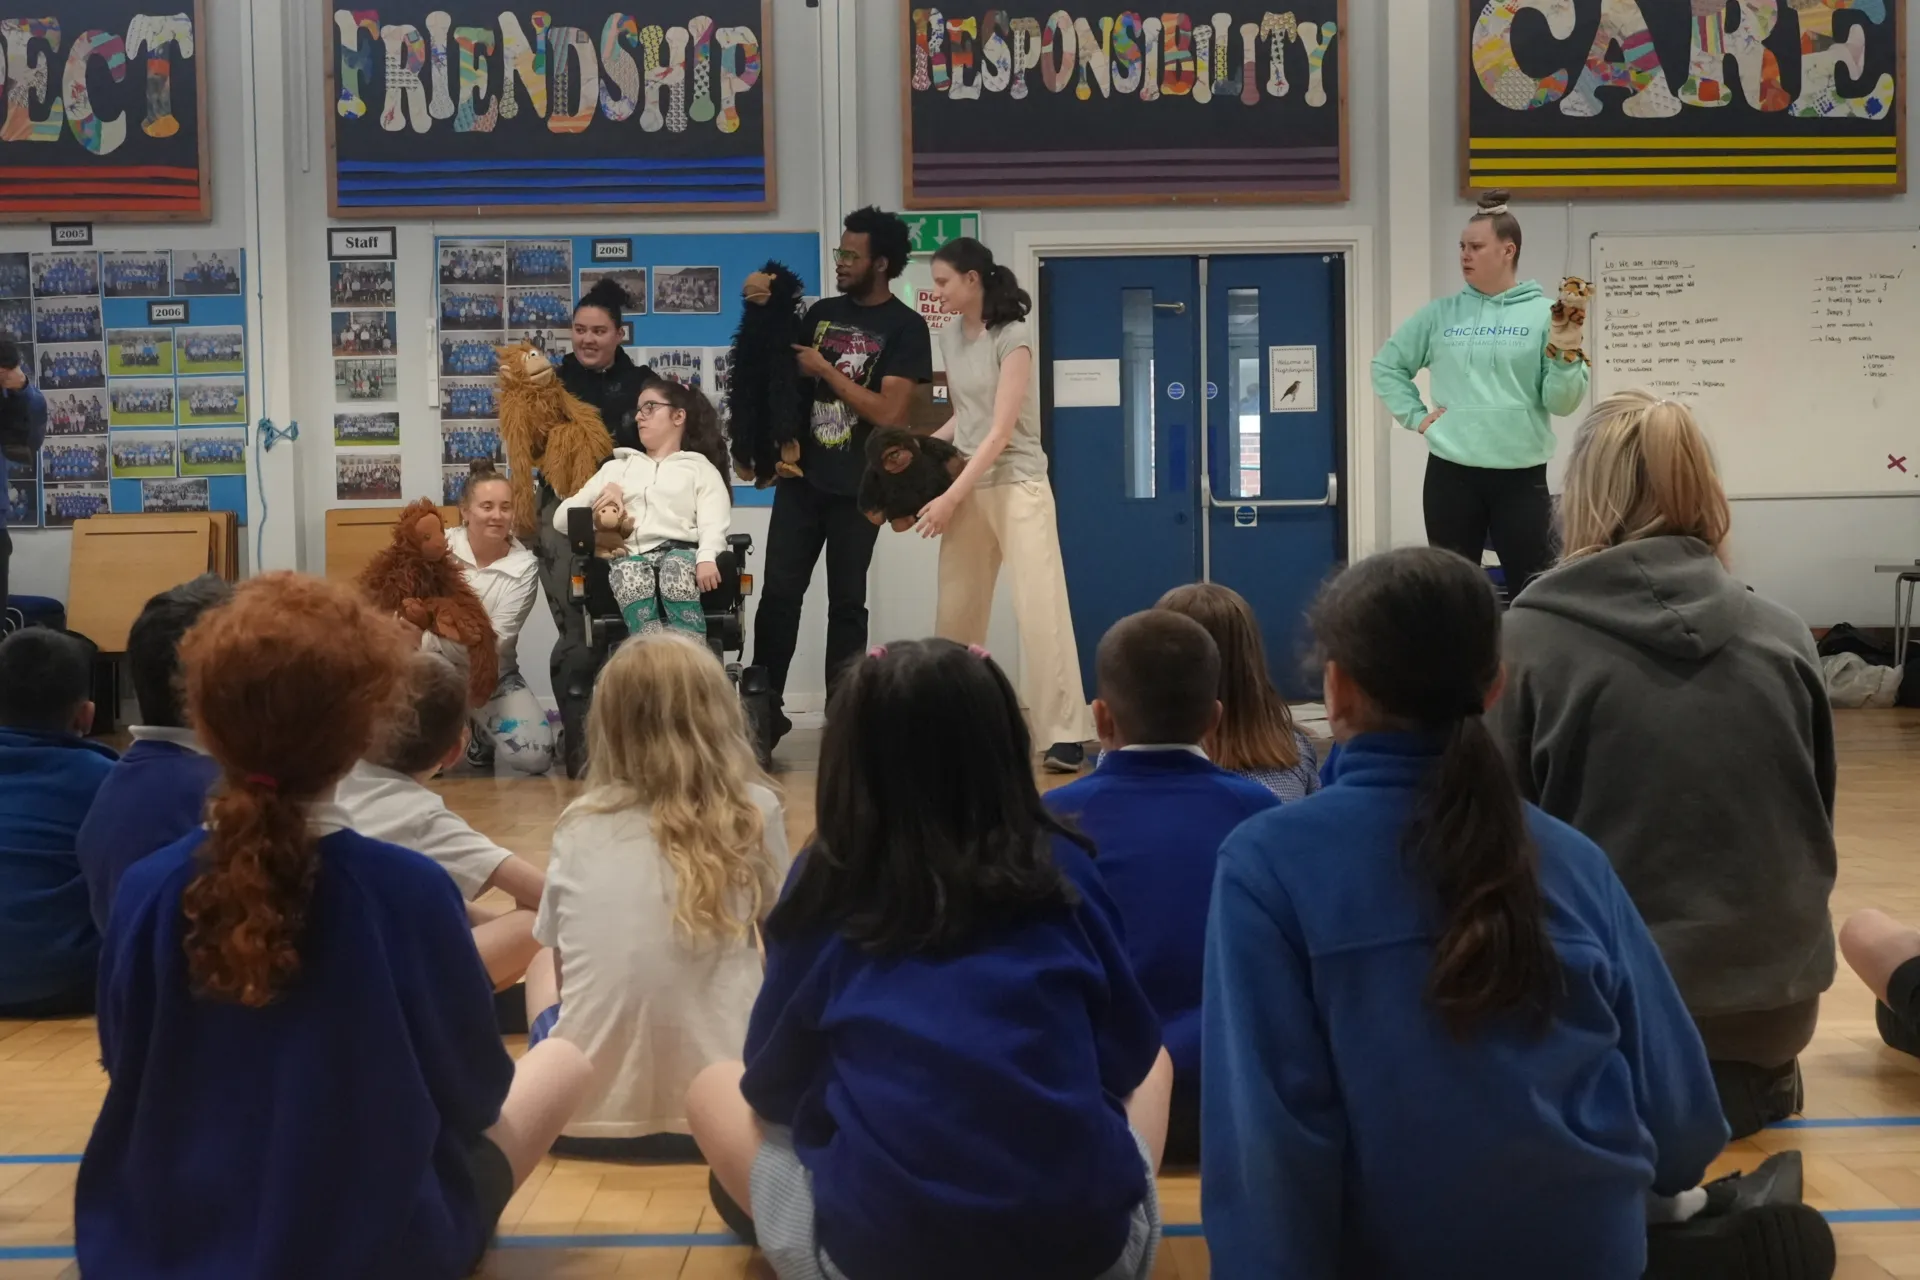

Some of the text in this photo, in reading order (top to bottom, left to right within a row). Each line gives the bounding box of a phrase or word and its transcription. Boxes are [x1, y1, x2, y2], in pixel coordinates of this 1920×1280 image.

[911, 8, 1337, 107] RESPONSIBILITY
[1472, 0, 1894, 120] CARE
[334, 10, 761, 133] FRIENDSHIP
[0, 13, 193, 155] ECT
[59, 230, 85, 239] 2005
[345, 236, 379, 249] Staff
[599, 246, 625, 255] 2008
[1651, 259, 1679, 268] learning
[155, 308, 181, 317] 2006
[1443, 326, 1529, 337] CHICKENSHED
